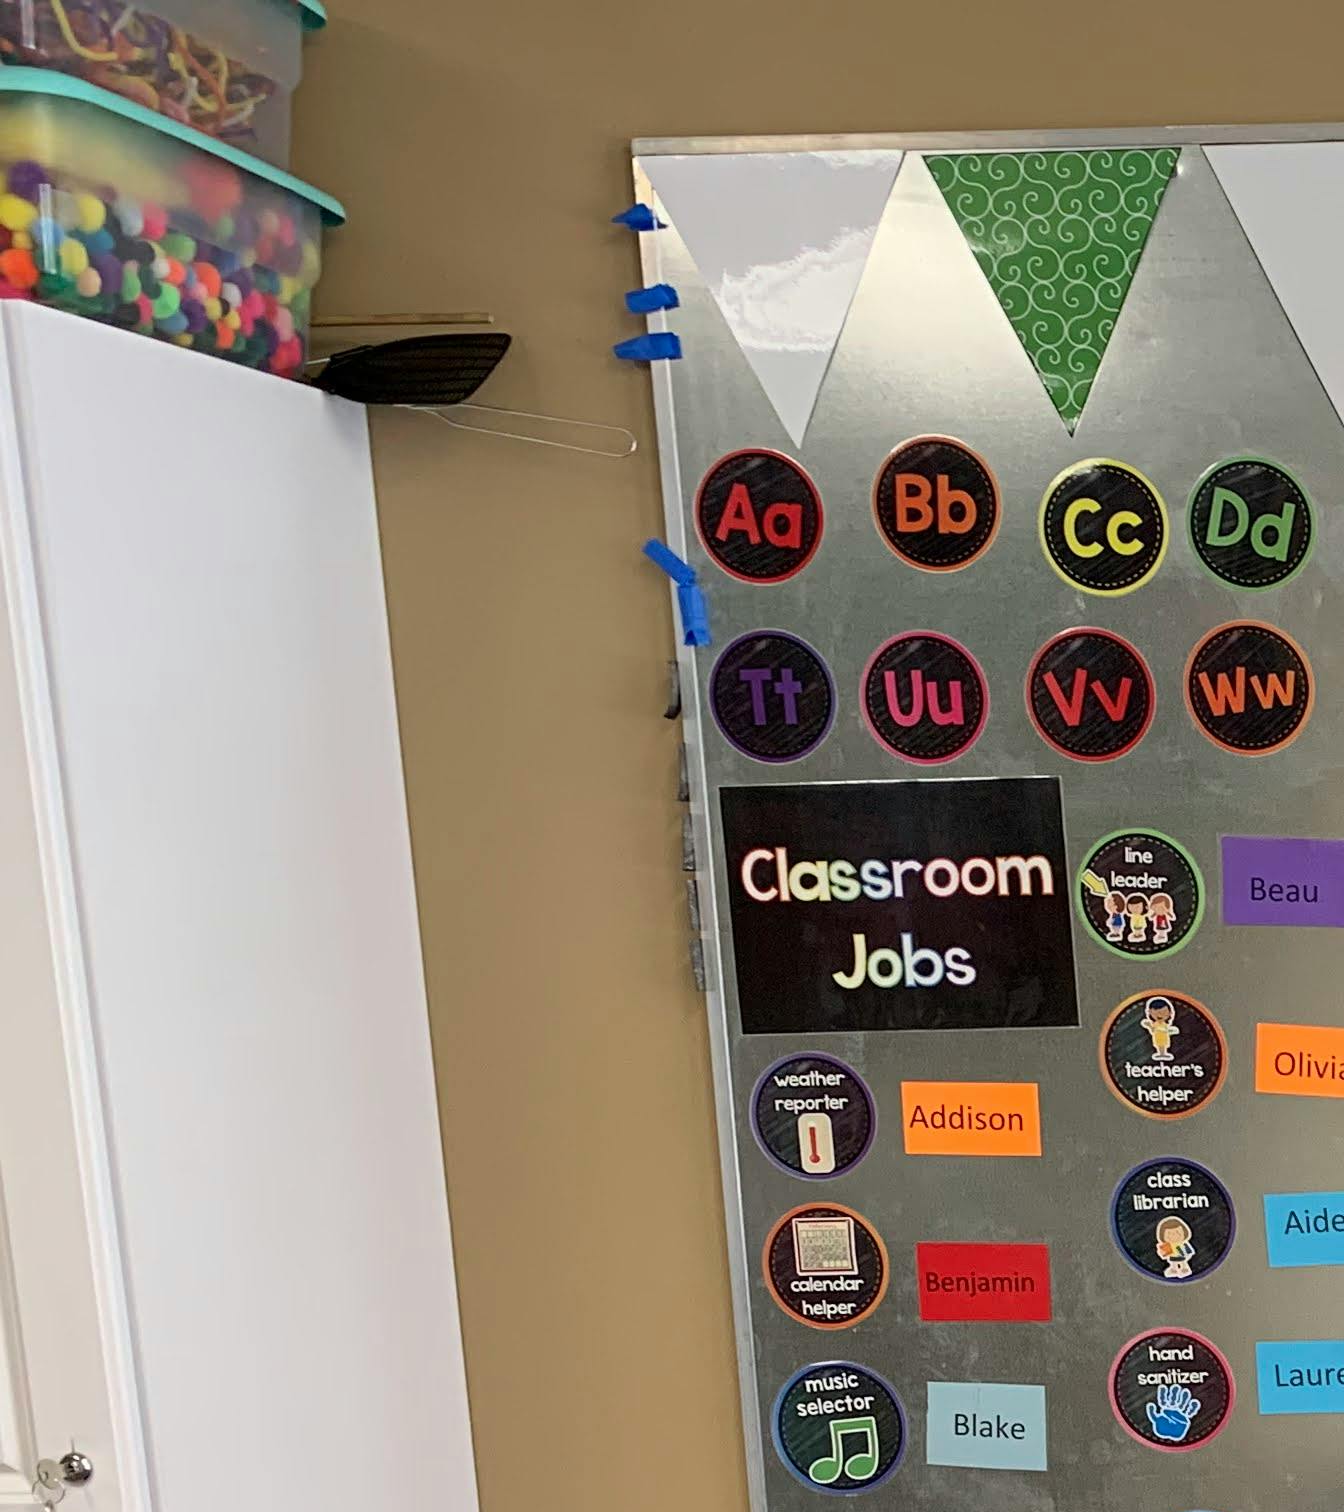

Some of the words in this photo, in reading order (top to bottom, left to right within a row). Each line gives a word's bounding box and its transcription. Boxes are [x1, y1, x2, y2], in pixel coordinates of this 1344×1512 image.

[895, 474, 977, 534] Bb
[715, 483, 802, 549] Aa
[1062, 497, 1143, 558] Cc
[1204, 488, 1296, 561] Dd
[739, 668, 801, 726] Tt
[884, 670, 964, 728] Uu
[1044, 668, 1133, 727] Vv
[1199, 667, 1296, 718] Ww
[1125, 847, 1153, 864] line
[741, 847, 1054, 901] Classroom
[1110, 871, 1167, 889] leader
[1251, 877, 1318, 903] Beau
[832, 933, 976, 989] Jobs
[773, 1071, 845, 1088] weather
[1125, 1061, 1204, 1078] teacher's
[774, 1095, 848, 1114] reporter
[1137, 1085, 1194, 1105] helper
[910, 1104, 1023, 1131] Addison
[1147, 1173, 1191, 1188] class
[1133, 1193, 1209, 1211] librarian
[790, 1276, 864, 1293] calendar
[926, 1272, 1035, 1297] Benjamin
[802, 1300, 856, 1318] helper
[1148, 1345, 1193, 1362] hand
[804, 1372, 859, 1393] music
[1137, 1368, 1209, 1385] sanitizer
[796, 1395, 874, 1416] selector
[954, 1414, 1025, 1440] Blake
